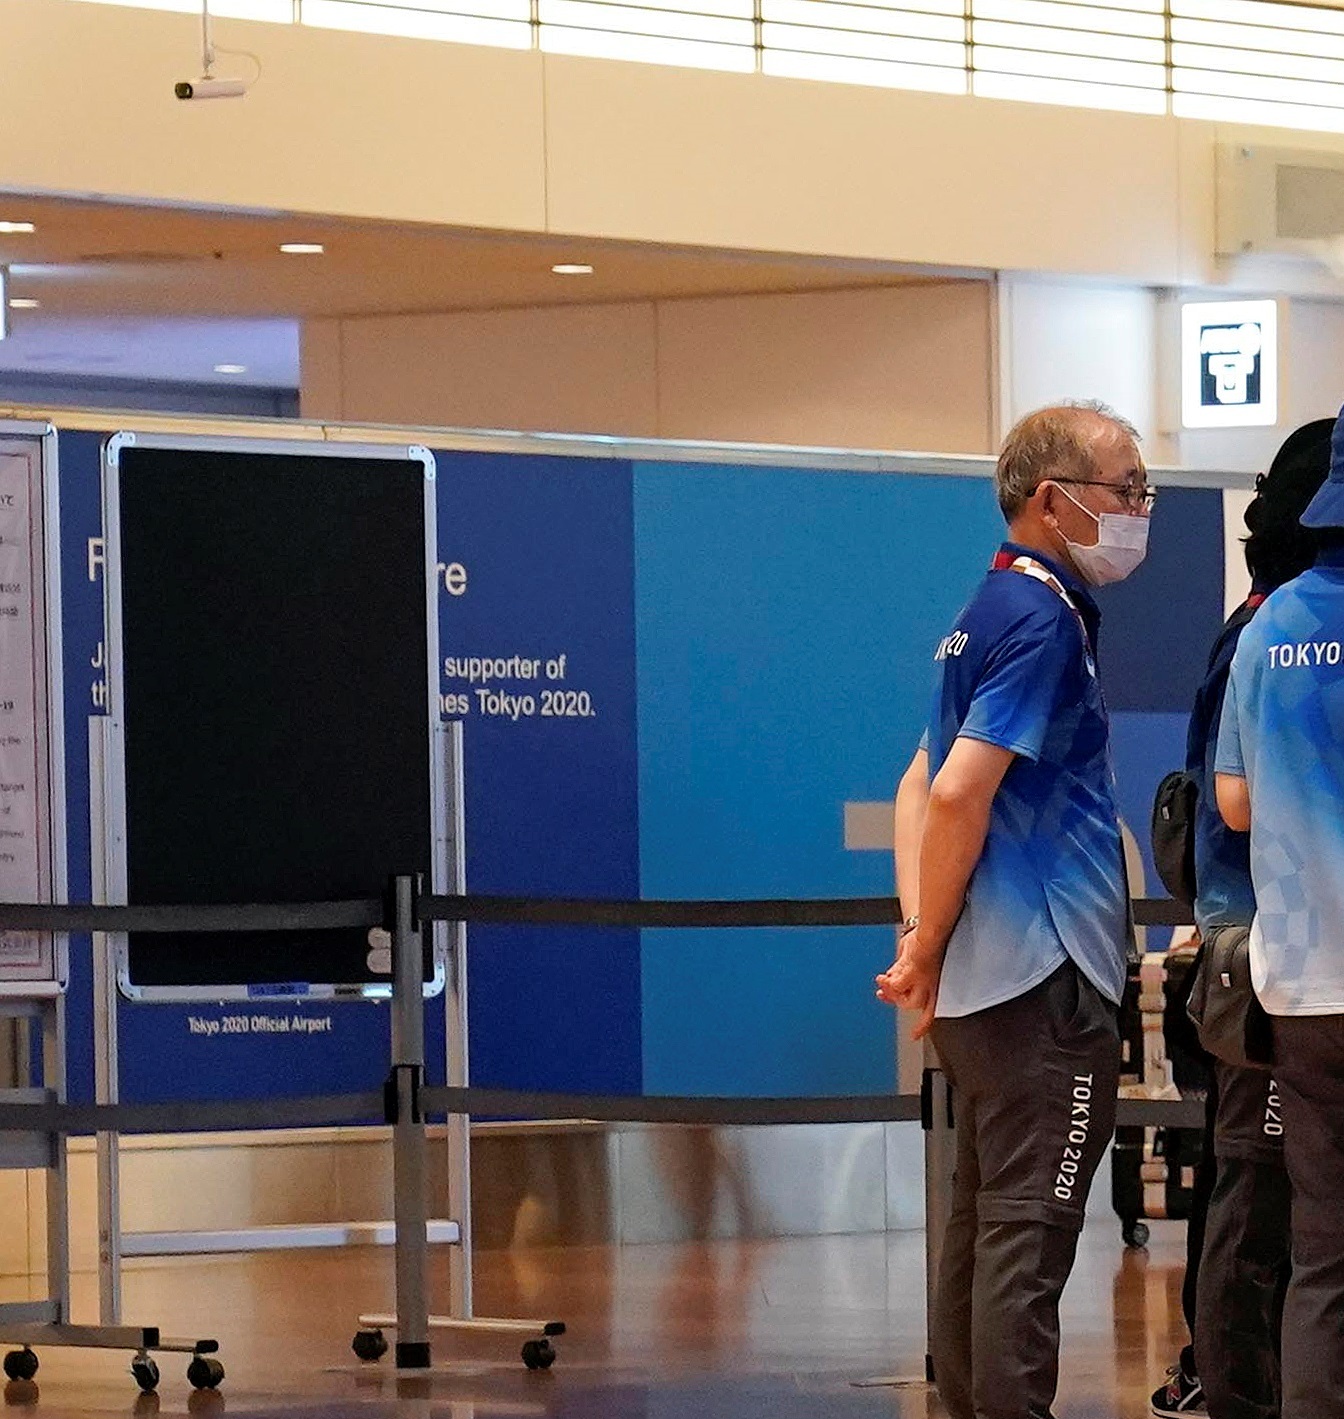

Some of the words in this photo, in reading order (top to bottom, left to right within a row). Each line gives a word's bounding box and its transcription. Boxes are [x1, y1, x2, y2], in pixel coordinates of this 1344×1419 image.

[445, 655, 541, 683] supporter
[546, 653, 567, 680] of
[1268, 641, 1341, 669] TOKYO
[475, 688, 536, 721] Tokyo
[541, 690, 596, 716] 2020.
[188, 1016, 220, 1036] Tokyo
[291, 1014, 332, 1035] Airport
[1068, 1073, 1094, 1145] TOKYO
[1053, 1146, 1082, 1201] 2020
